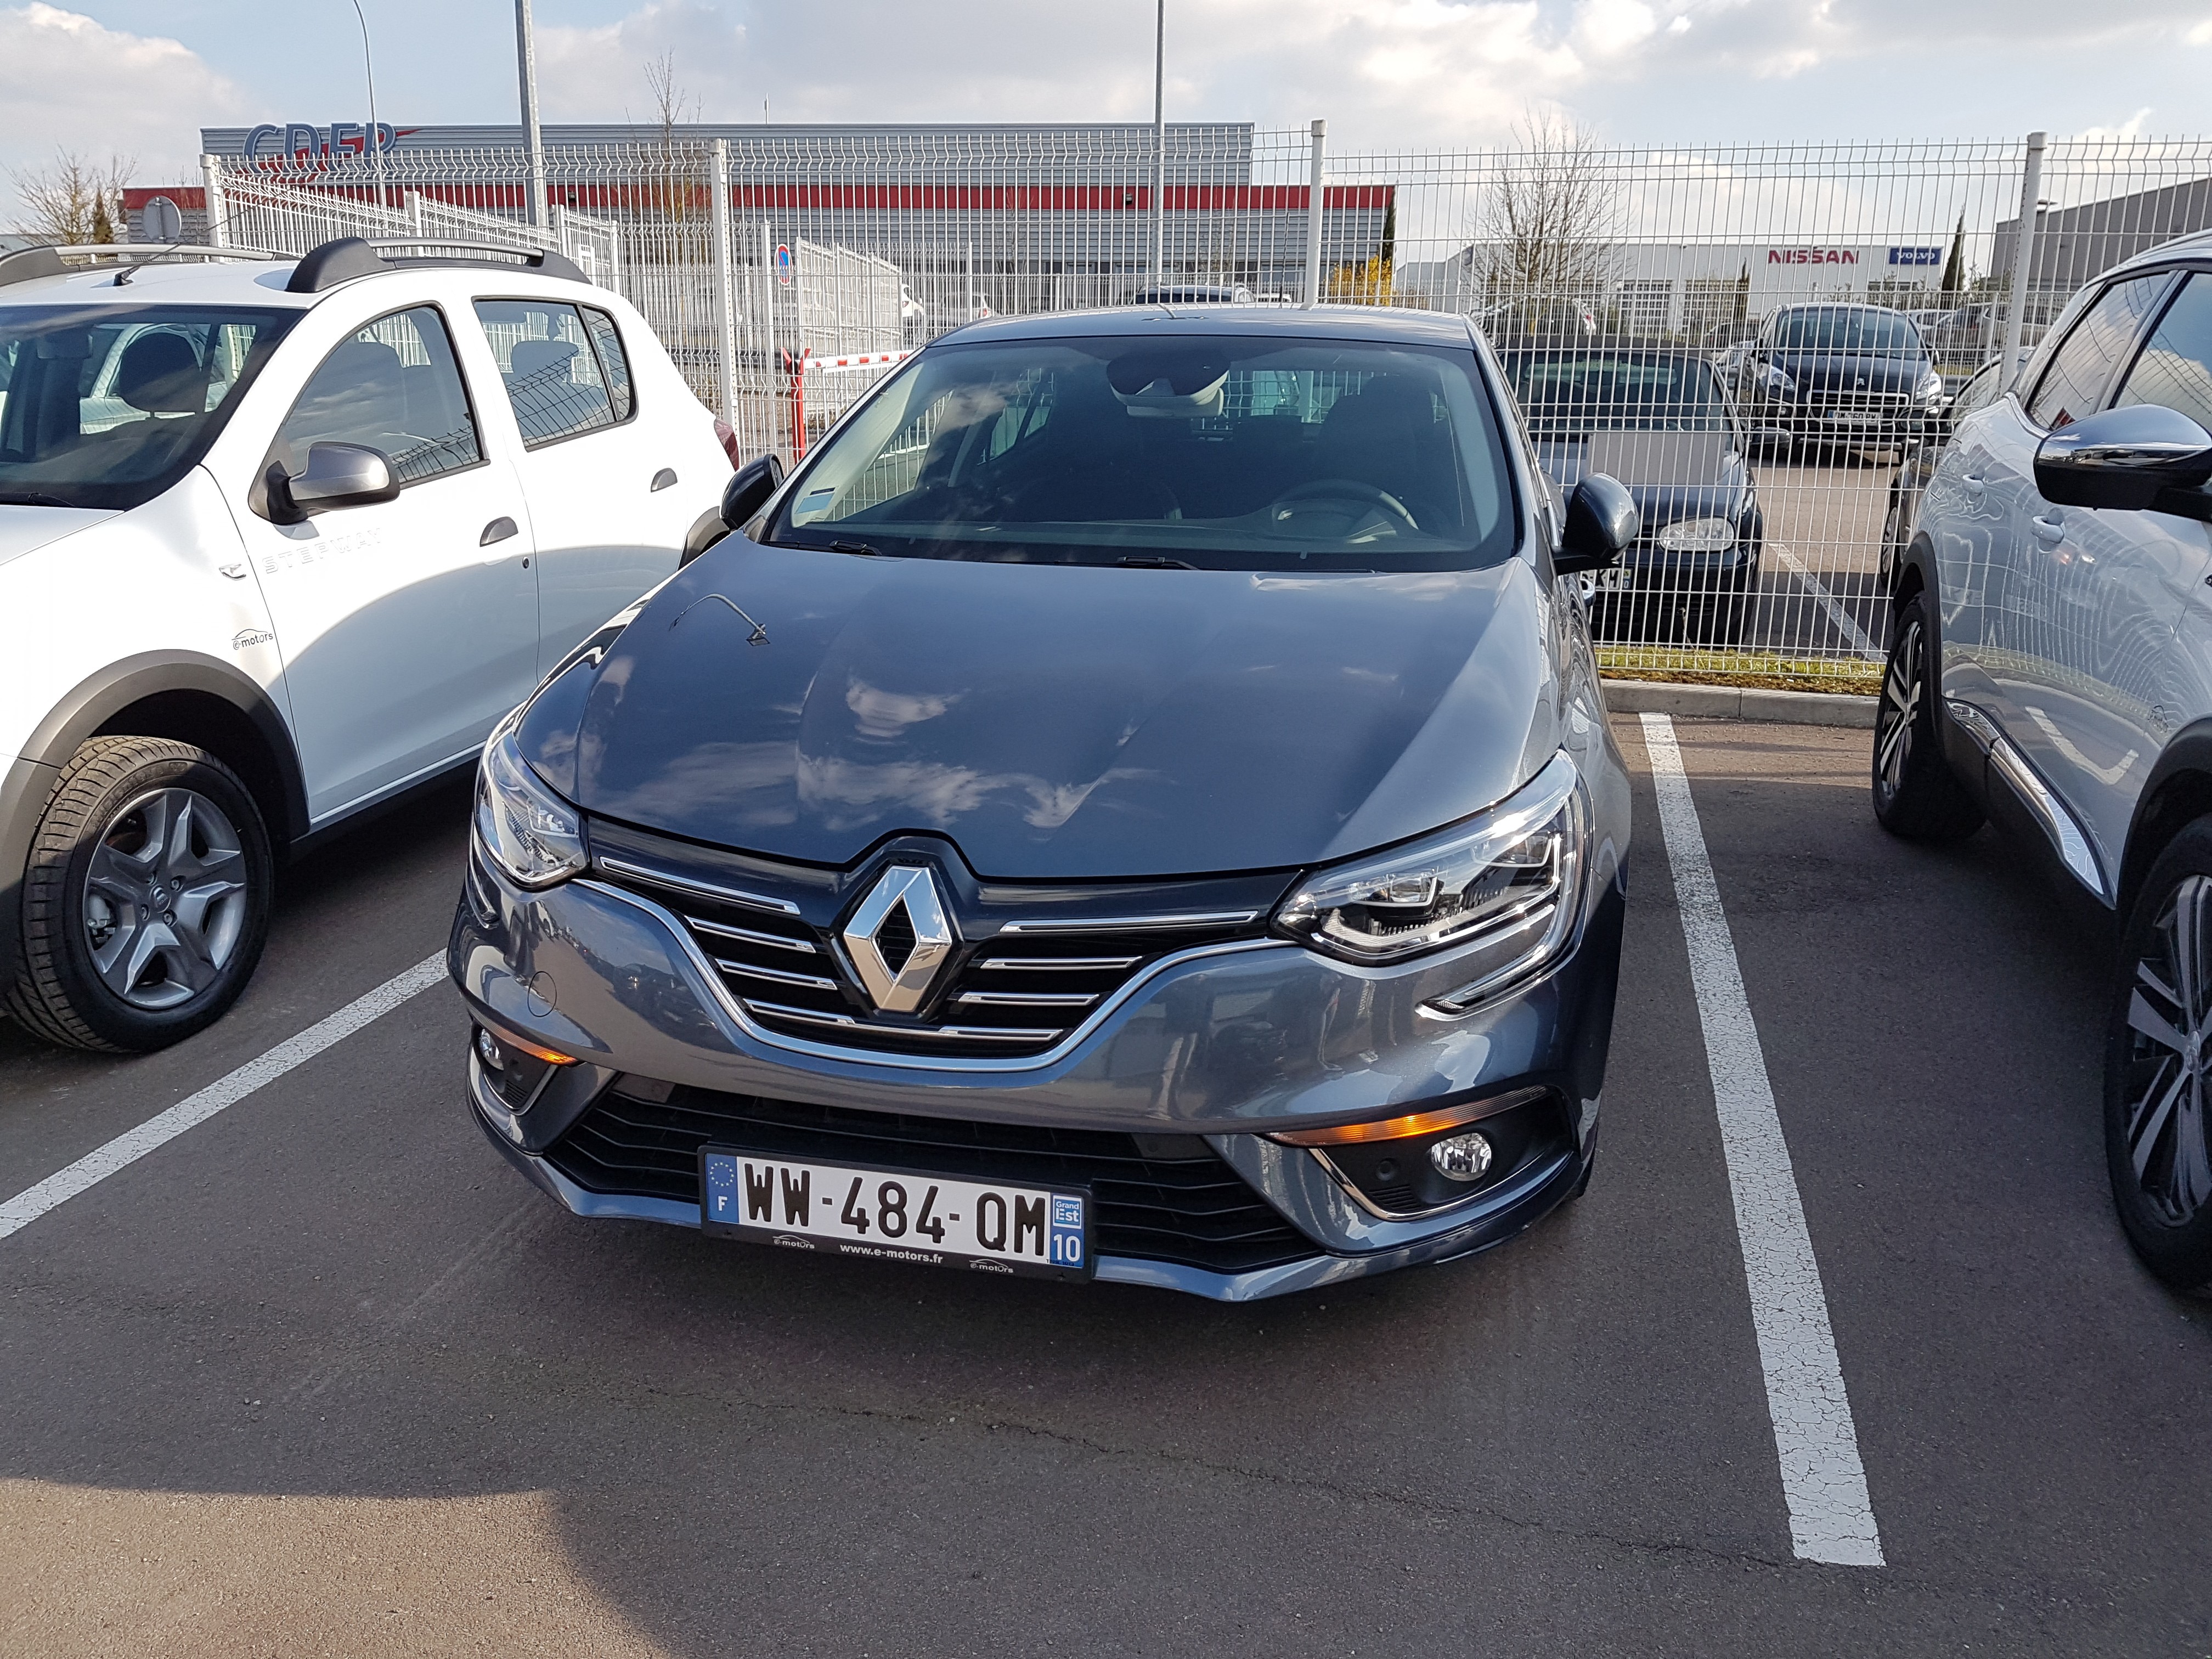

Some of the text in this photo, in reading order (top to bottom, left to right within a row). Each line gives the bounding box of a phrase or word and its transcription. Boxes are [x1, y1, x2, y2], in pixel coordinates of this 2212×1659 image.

[1768, 250, 1859, 264] NISSAN
[262, 528, 381, 574] STEPWAY
[718, 1195, 728, 1211] F
[1056, 1201, 1079, 1210] Grand
[1056, 1207, 1079, 1222] Est
[839, 1244, 943, 1263] www.e-motors.fr
[1053, 1234, 1080, 1262] 10
